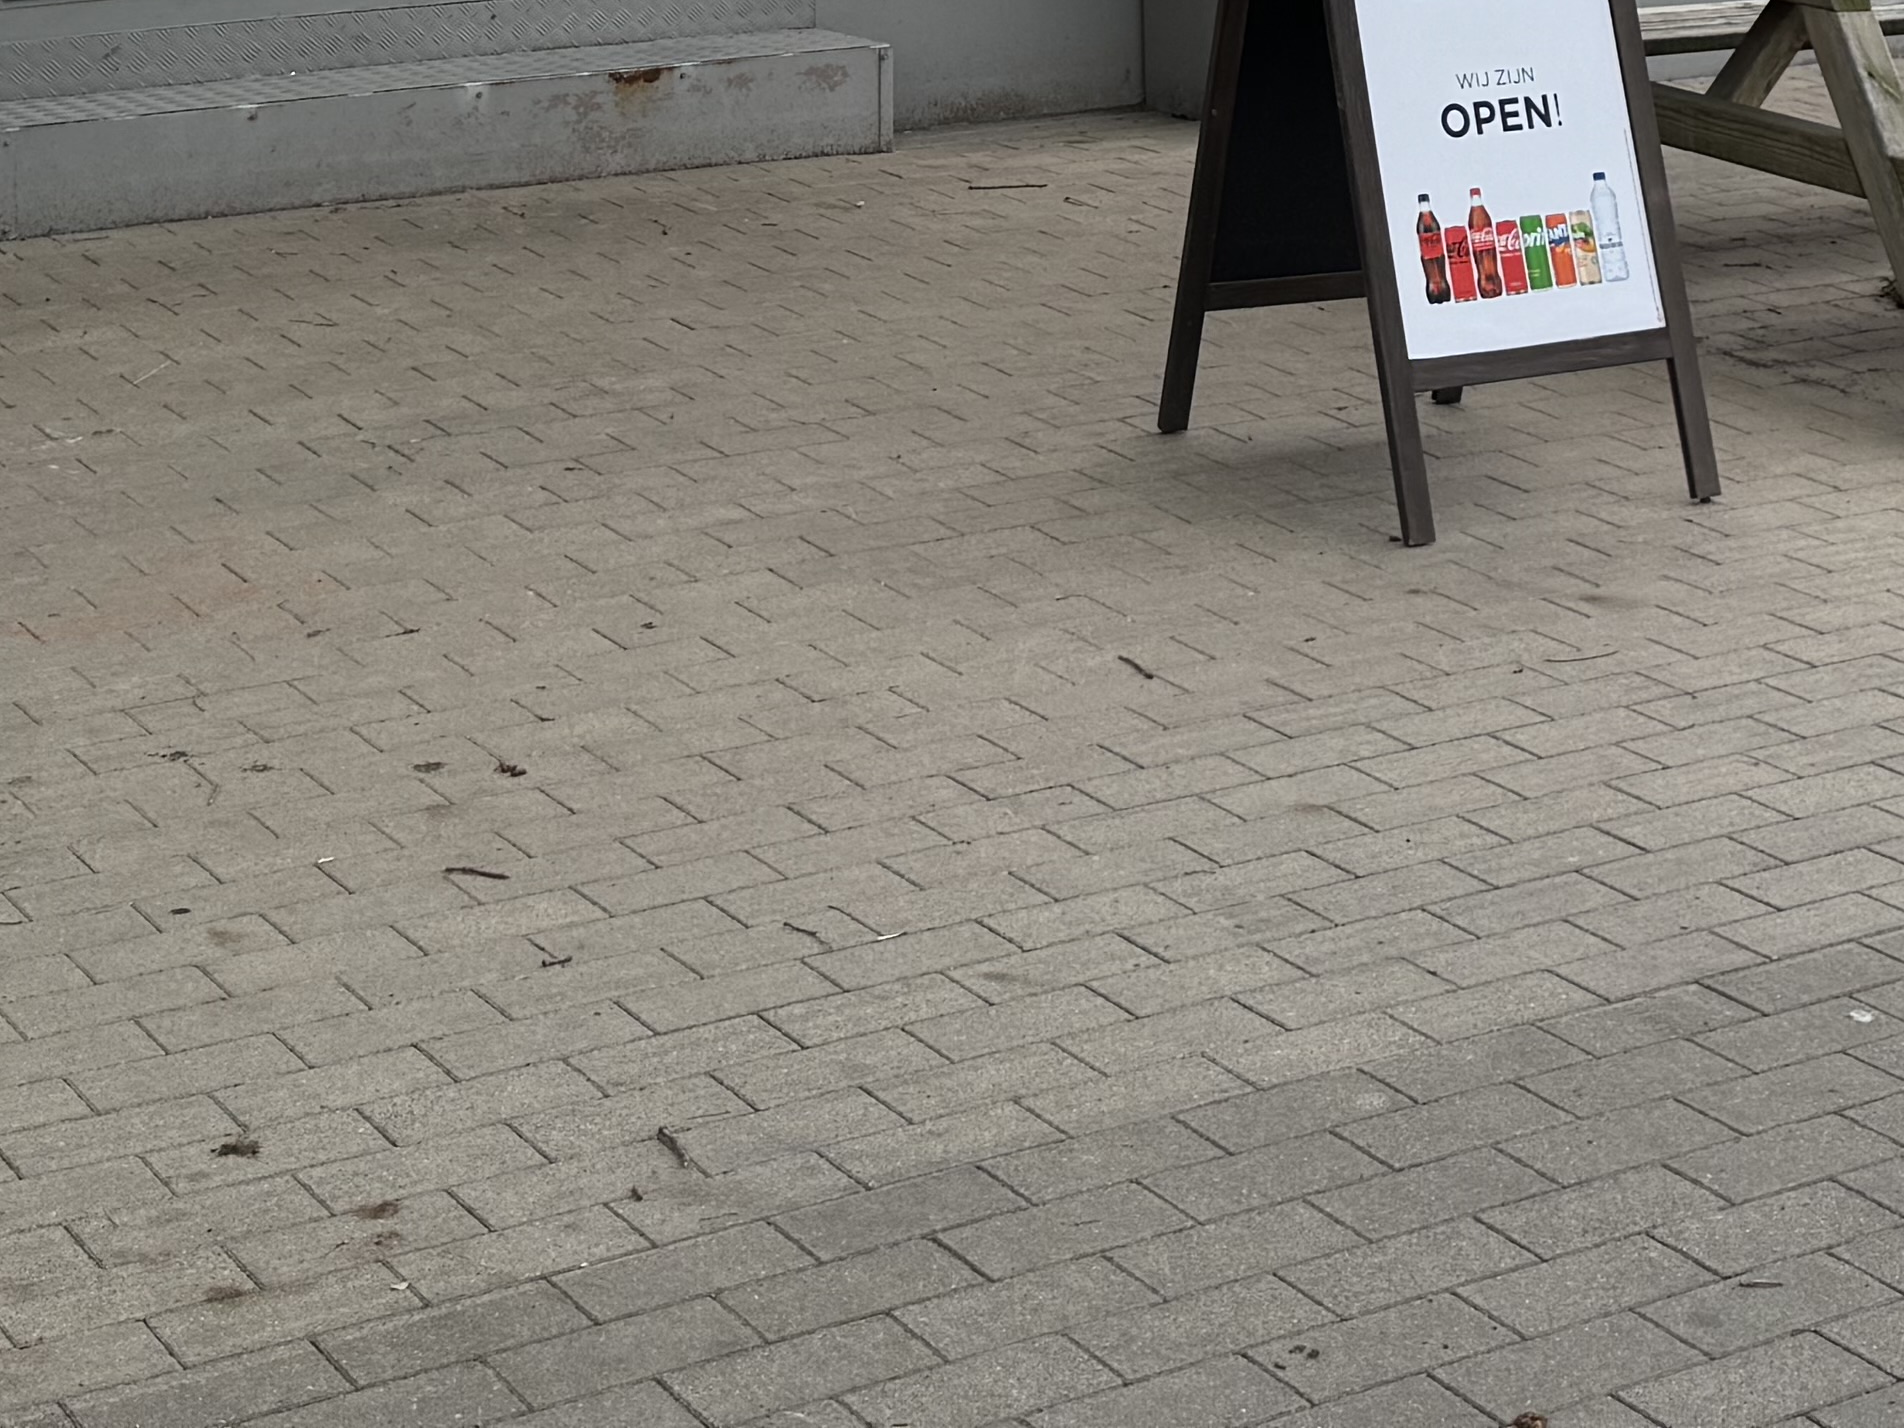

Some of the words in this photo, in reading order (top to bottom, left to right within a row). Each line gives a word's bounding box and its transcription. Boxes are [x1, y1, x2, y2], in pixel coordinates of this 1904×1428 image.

[1455, 72, 1490, 90] WIJ
[1494, 66, 1536, 87] ZIJN
[1440, 92, 1563, 139] OPEN!
